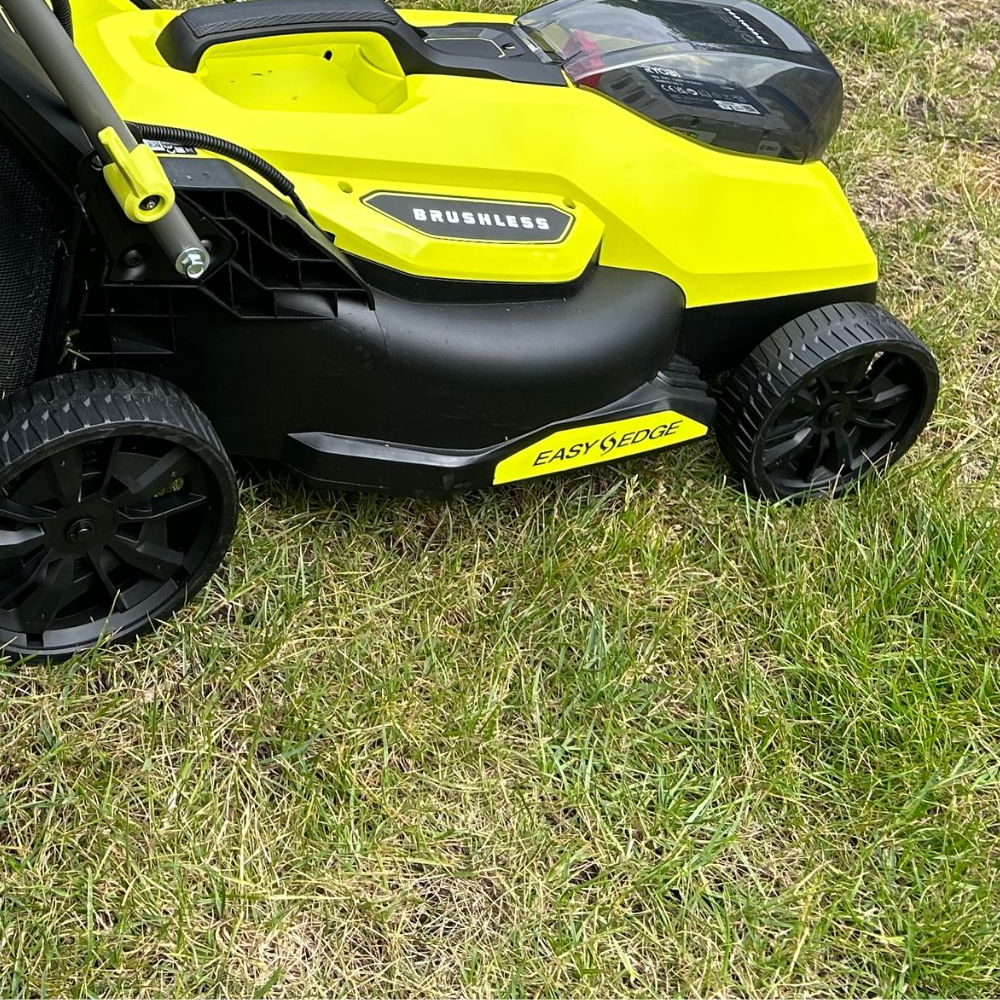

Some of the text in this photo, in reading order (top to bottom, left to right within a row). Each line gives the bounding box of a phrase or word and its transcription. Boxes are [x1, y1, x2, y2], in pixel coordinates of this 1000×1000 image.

[643, 64, 682, 78] RYOBI
[412, 207, 551, 231] BRUSHLESS
[532, 419, 684, 468] EASY EDGE
